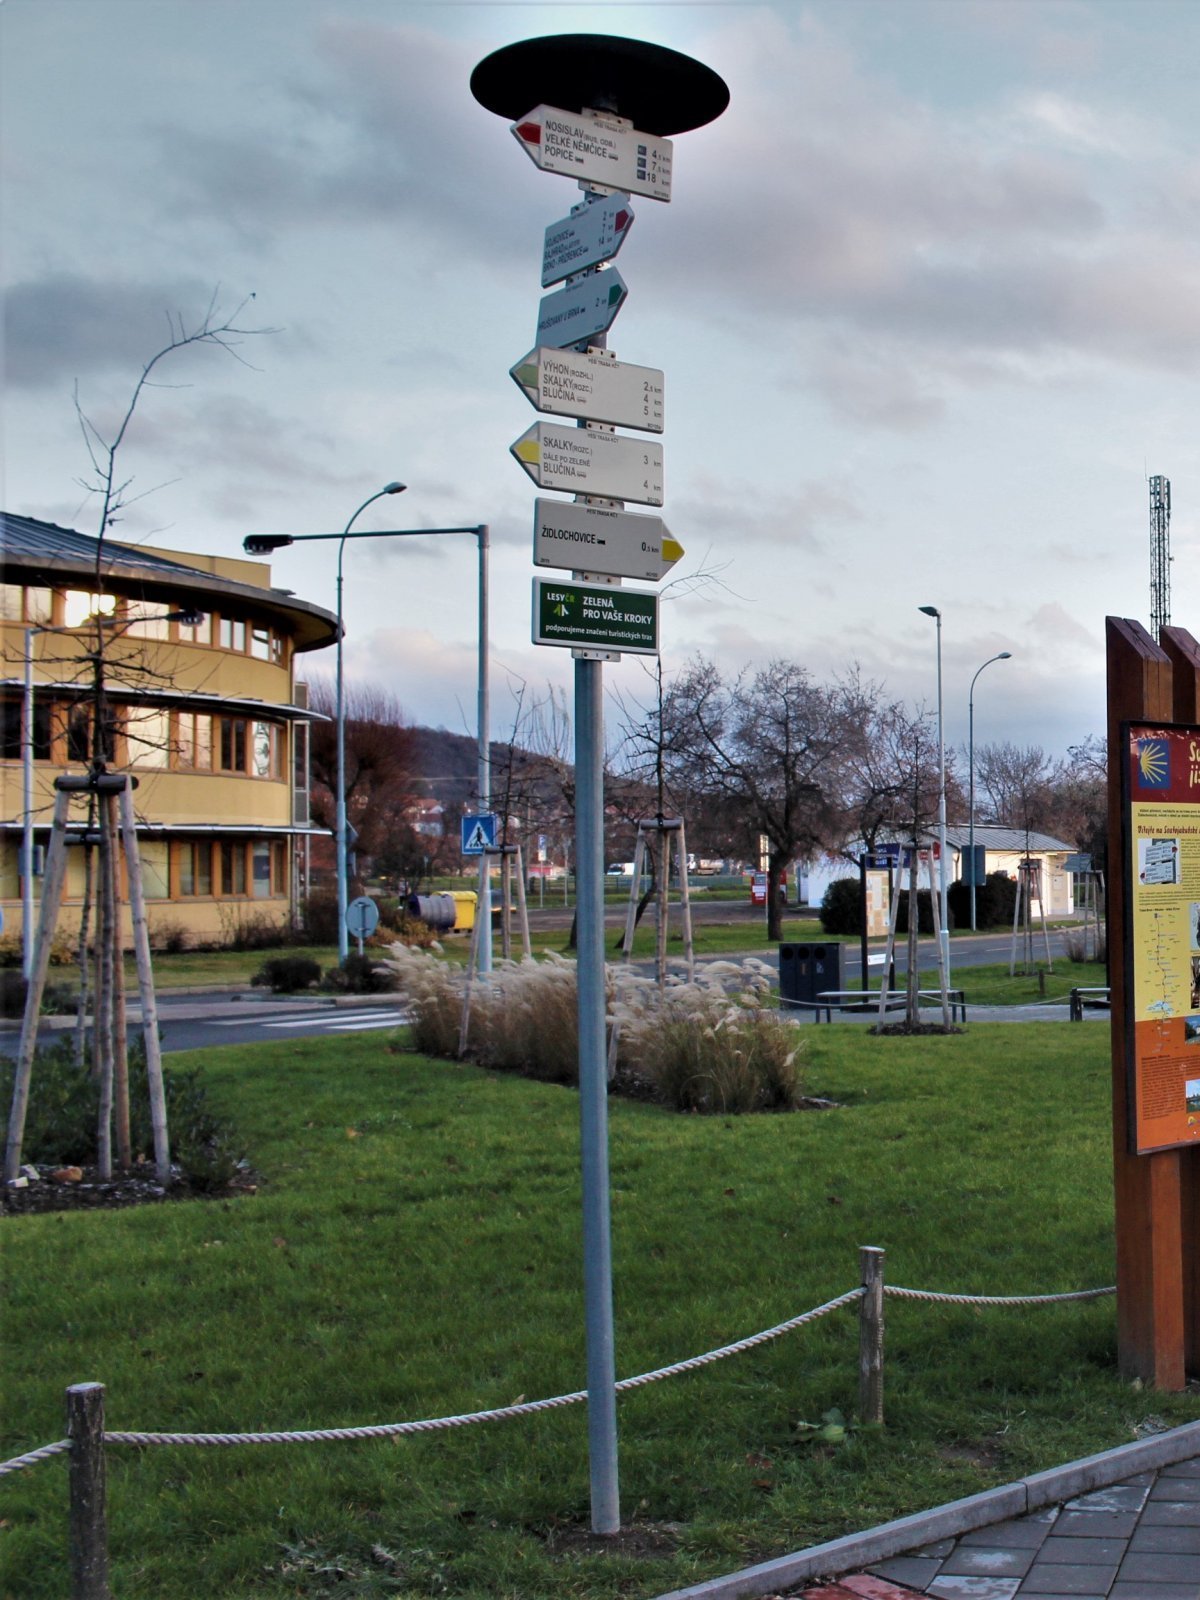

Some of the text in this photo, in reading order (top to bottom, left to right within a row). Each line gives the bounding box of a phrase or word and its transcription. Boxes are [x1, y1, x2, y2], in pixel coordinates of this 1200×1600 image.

[546, 120, 584, 138] NOSISLAV
[546, 132, 571, 148] VELKÉ
[572, 139, 607, 158] NĚMČICE
[544, 145, 574, 161] POPICE
[647, 172, 656, 183] 18
[595, 297, 599, 307] 2
[543, 360, 569, 375] VÝHON
[543, 374, 573, 388] SKALKY
[643, 394, 648, 403] 4
[542, 386, 575, 402] BLUČINA
[643, 406, 648, 415] 5
[543, 437, 573, 451] SKALKY
[643, 455, 648, 465] 3
[543, 452, 559, 461] DÁLE
[569, 456, 591, 467] ZELENÉ
[543, 462, 576, 476] BLUČINA
[643, 480, 648, 489] 4
[542, 525, 596, 544] ŽIDLOCHOVICE
[547, 593, 565, 601] LESY
[583, 596, 614, 608] ZELENÁ
[583, 609, 652, 624] PRO VAŠE KROKY
[545, 624, 585, 634] podporujeme
[586, 628, 608, 636] značení
[609, 630, 640, 640] turistických
